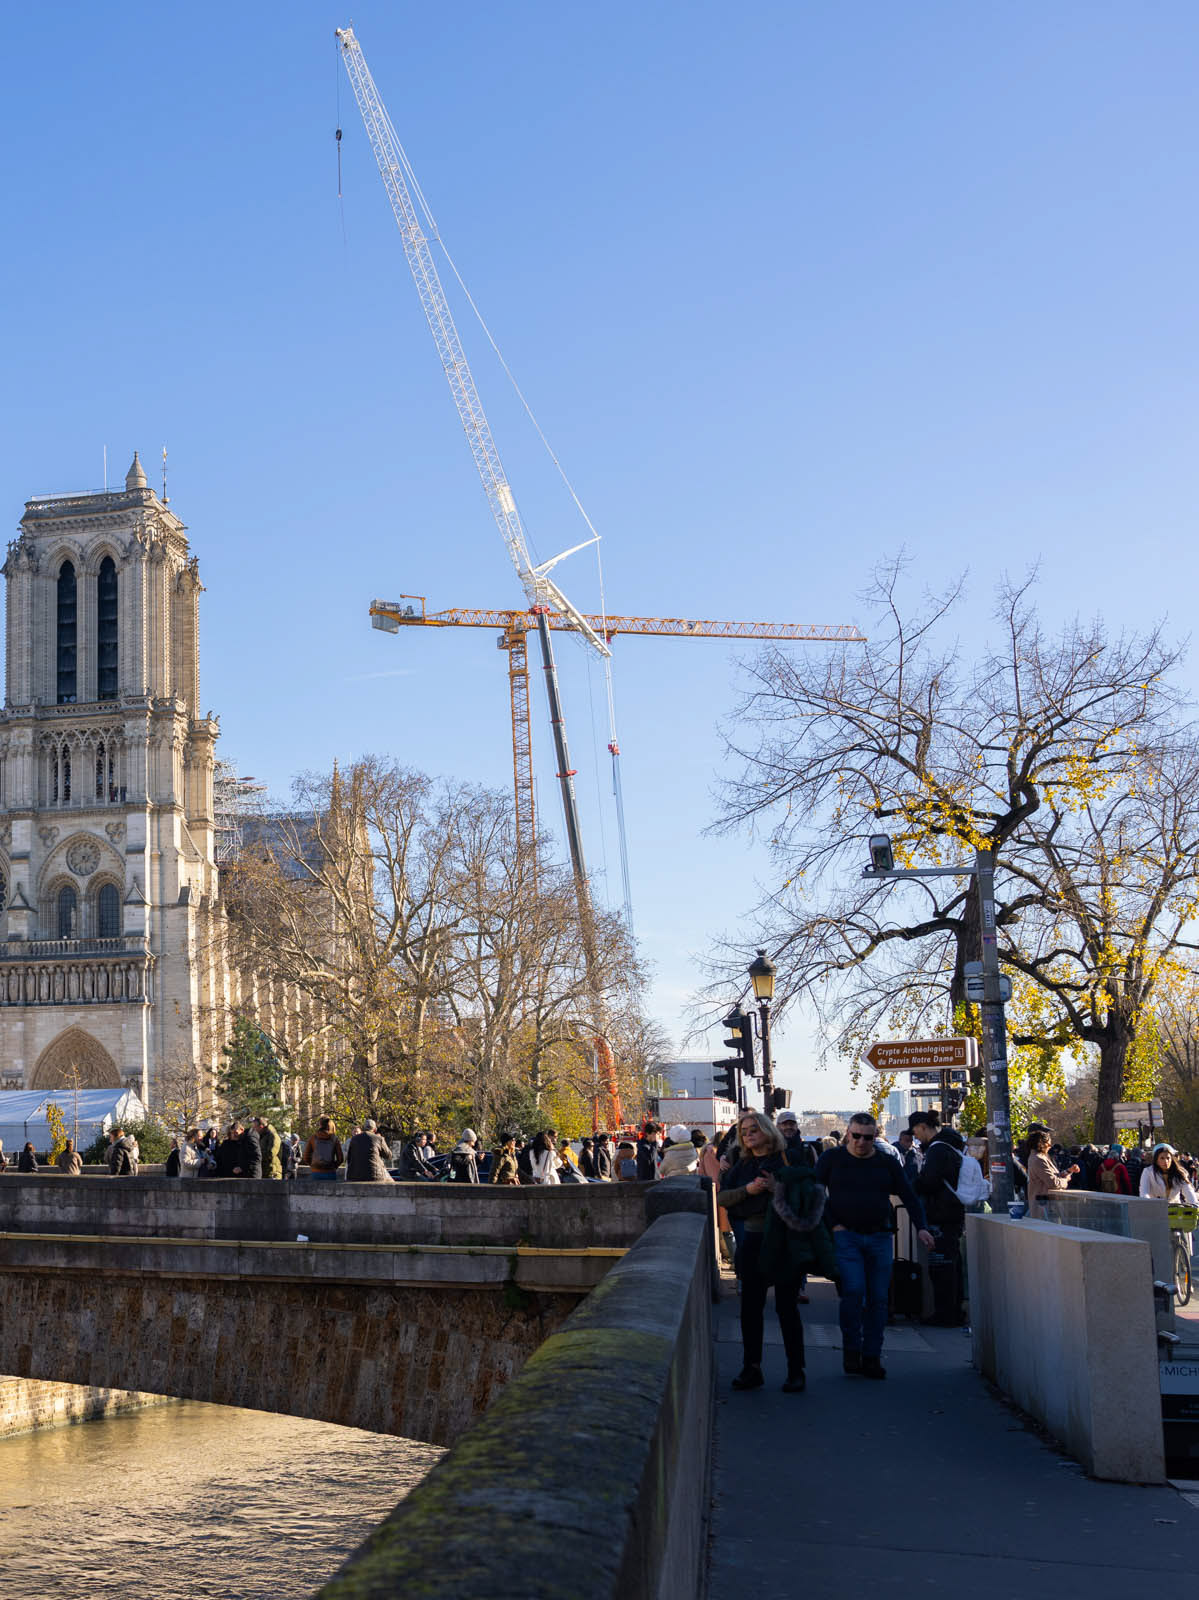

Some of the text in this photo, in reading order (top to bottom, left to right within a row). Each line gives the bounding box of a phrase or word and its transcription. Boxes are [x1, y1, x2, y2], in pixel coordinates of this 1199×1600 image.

[877, 1044, 954, 1057] Crypte Archéologique
[877, 1054, 954, 1066] du Parvis Notre Dame
